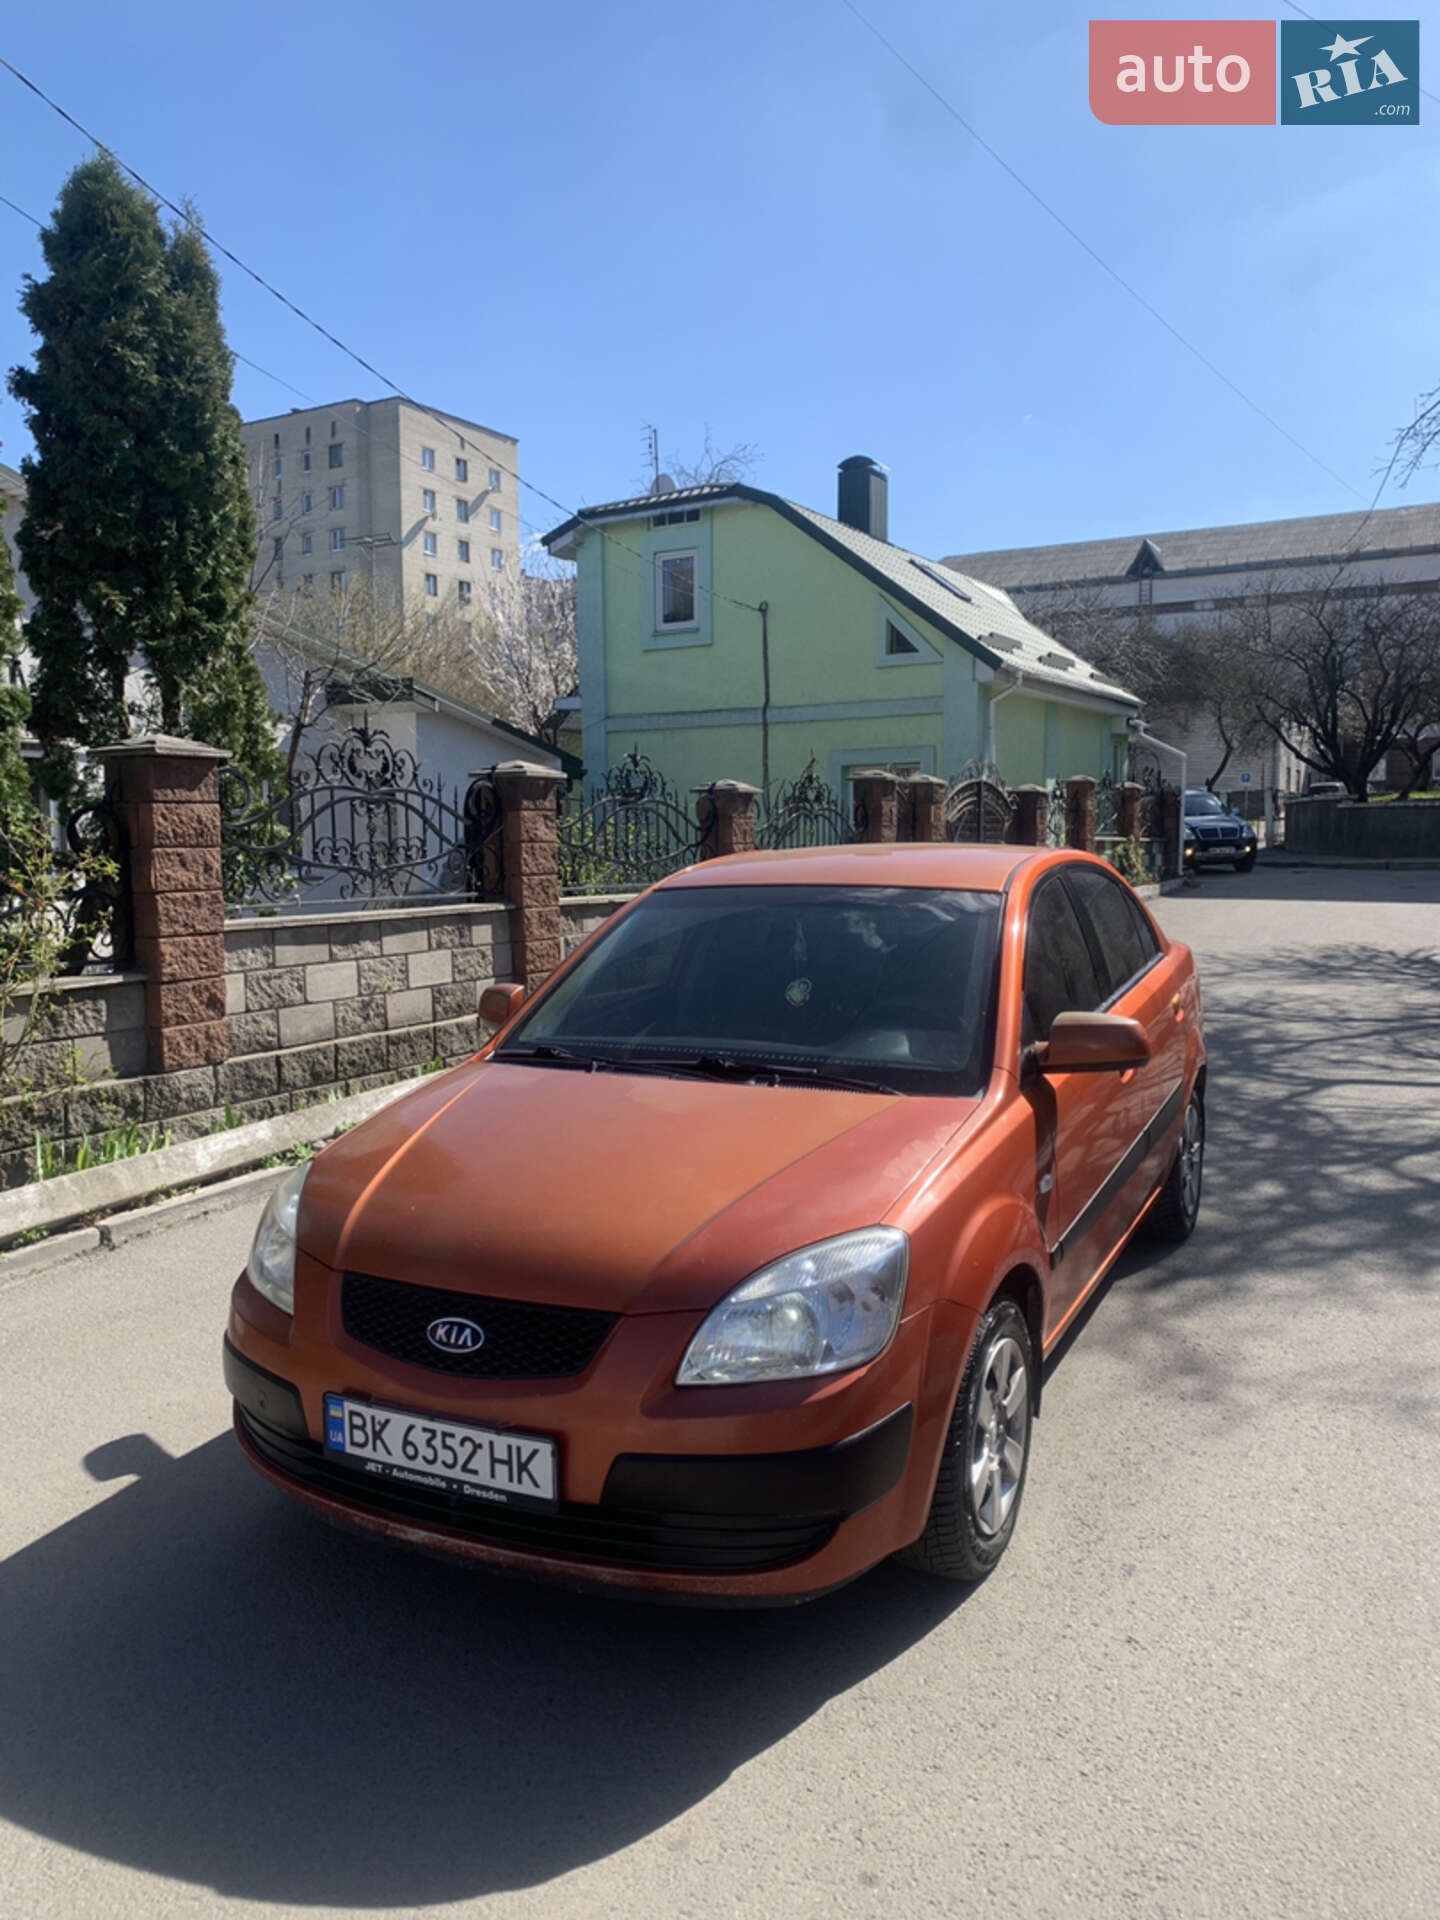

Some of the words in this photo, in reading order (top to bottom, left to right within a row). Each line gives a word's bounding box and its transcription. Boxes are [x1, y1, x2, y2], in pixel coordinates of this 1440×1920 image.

[435, 1323, 473, 1347] KIA
[329, 1430, 344, 1444] UA
[348, 1410, 393, 1457] BK
[401, 1424, 480, 1475] 6352
[488, 1440, 541, 1489] HK
[462, 1484, 507, 1502] Dresden
